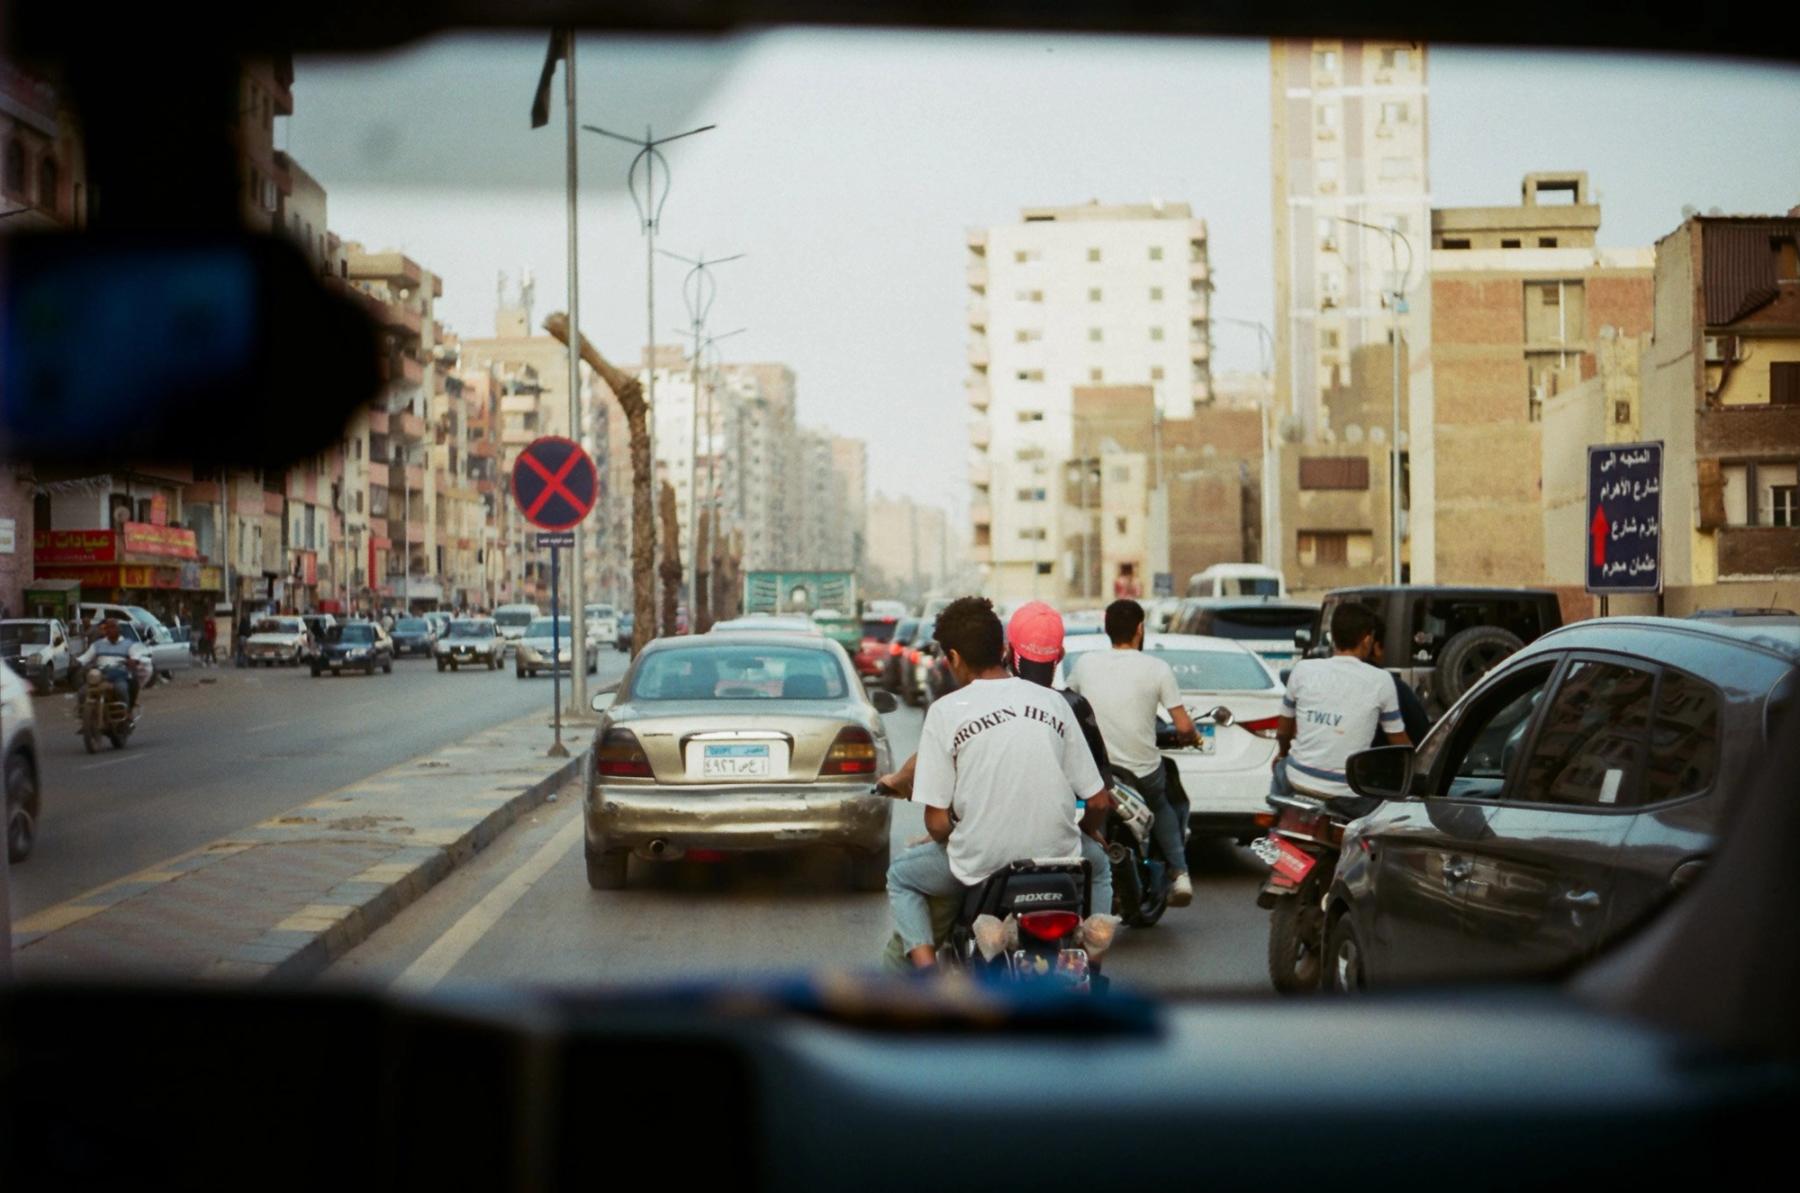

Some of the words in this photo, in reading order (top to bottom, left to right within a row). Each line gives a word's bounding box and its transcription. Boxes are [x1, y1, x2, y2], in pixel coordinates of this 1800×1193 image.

[1619, 448, 1650, 468] المتجه
[1633, 477, 1659, 501] شارع
[1611, 517, 1637, 541] شارع
[1602, 561, 1626, 578] محرم
[1629, 553, 1655, 576] عثمان
[1014, 892, 1063, 904] BOXER
